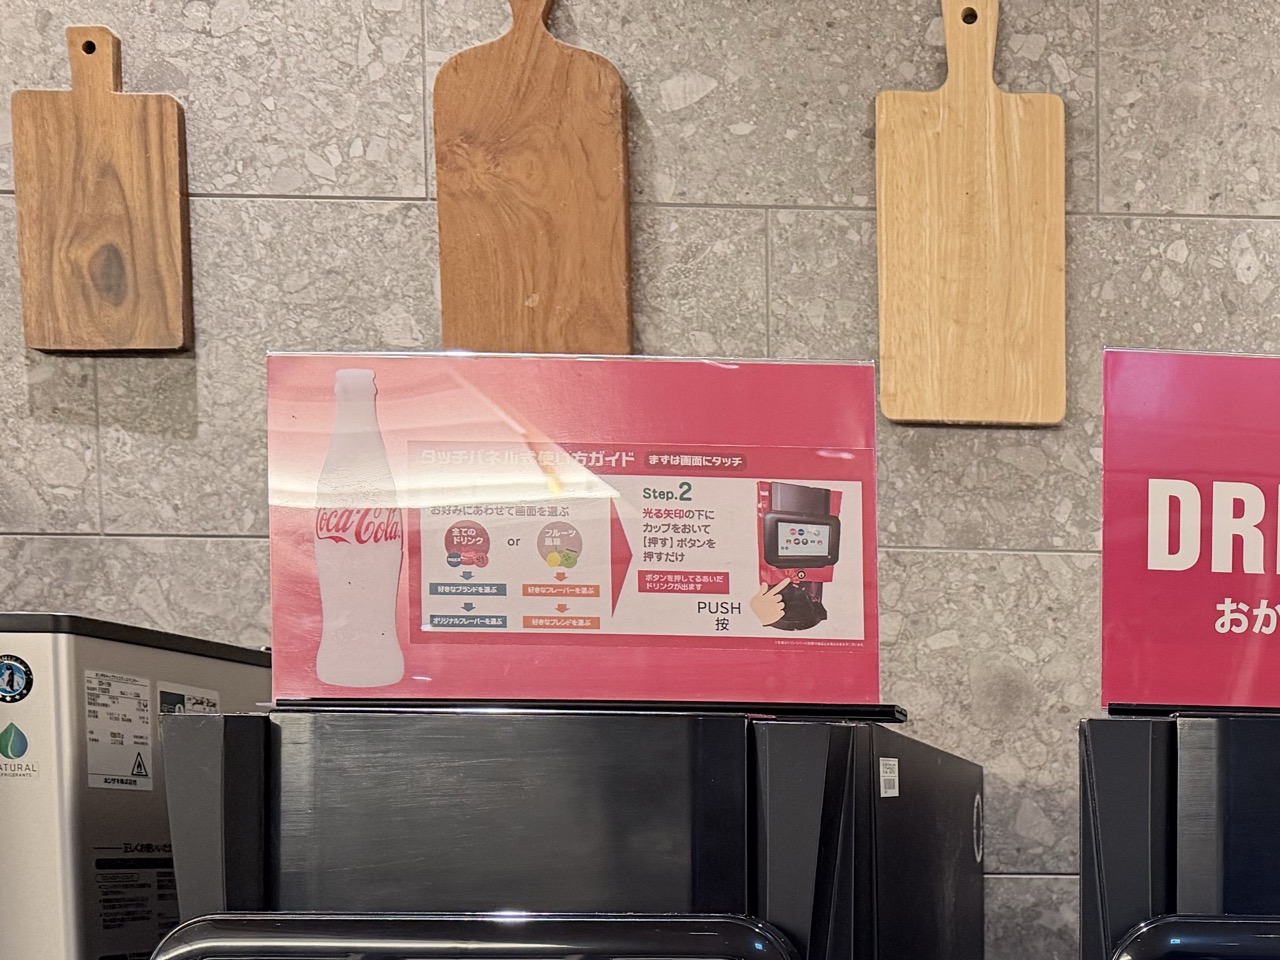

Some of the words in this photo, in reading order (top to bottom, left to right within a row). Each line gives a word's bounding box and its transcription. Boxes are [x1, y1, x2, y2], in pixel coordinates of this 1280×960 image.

[648, 455, 743, 468] まずは画面にタッチ
[643, 481, 692, 501] Step.2
[430, 505, 570, 517] お好みにあわせて画面を選ぶ
[643, 508, 715, 520] 光る矢印の下に
[452, 527, 477, 537] 全ての
[643, 522, 711, 534] カップをおいて
[545, 529, 576, 538] フルーツ
[453, 536, 484, 545] ドリンク
[507, 537, 520, 546] or
[643, 551, 685, 563] 押すだけ
[645, 574, 724, 583] ボタンを押してるあいだ
[437, 585, 498, 594] 好きなブランドを選ぶ
[527, 586, 595, 594] 好きなフレーバーを選ぶ
[646, 583, 702, 591] ドリンクが出ます
[697, 601, 742, 615] PUSH
[432, 617, 503, 626] オリジナルフレーバーを選ぶ
[715, 617, 730, 632] 按
